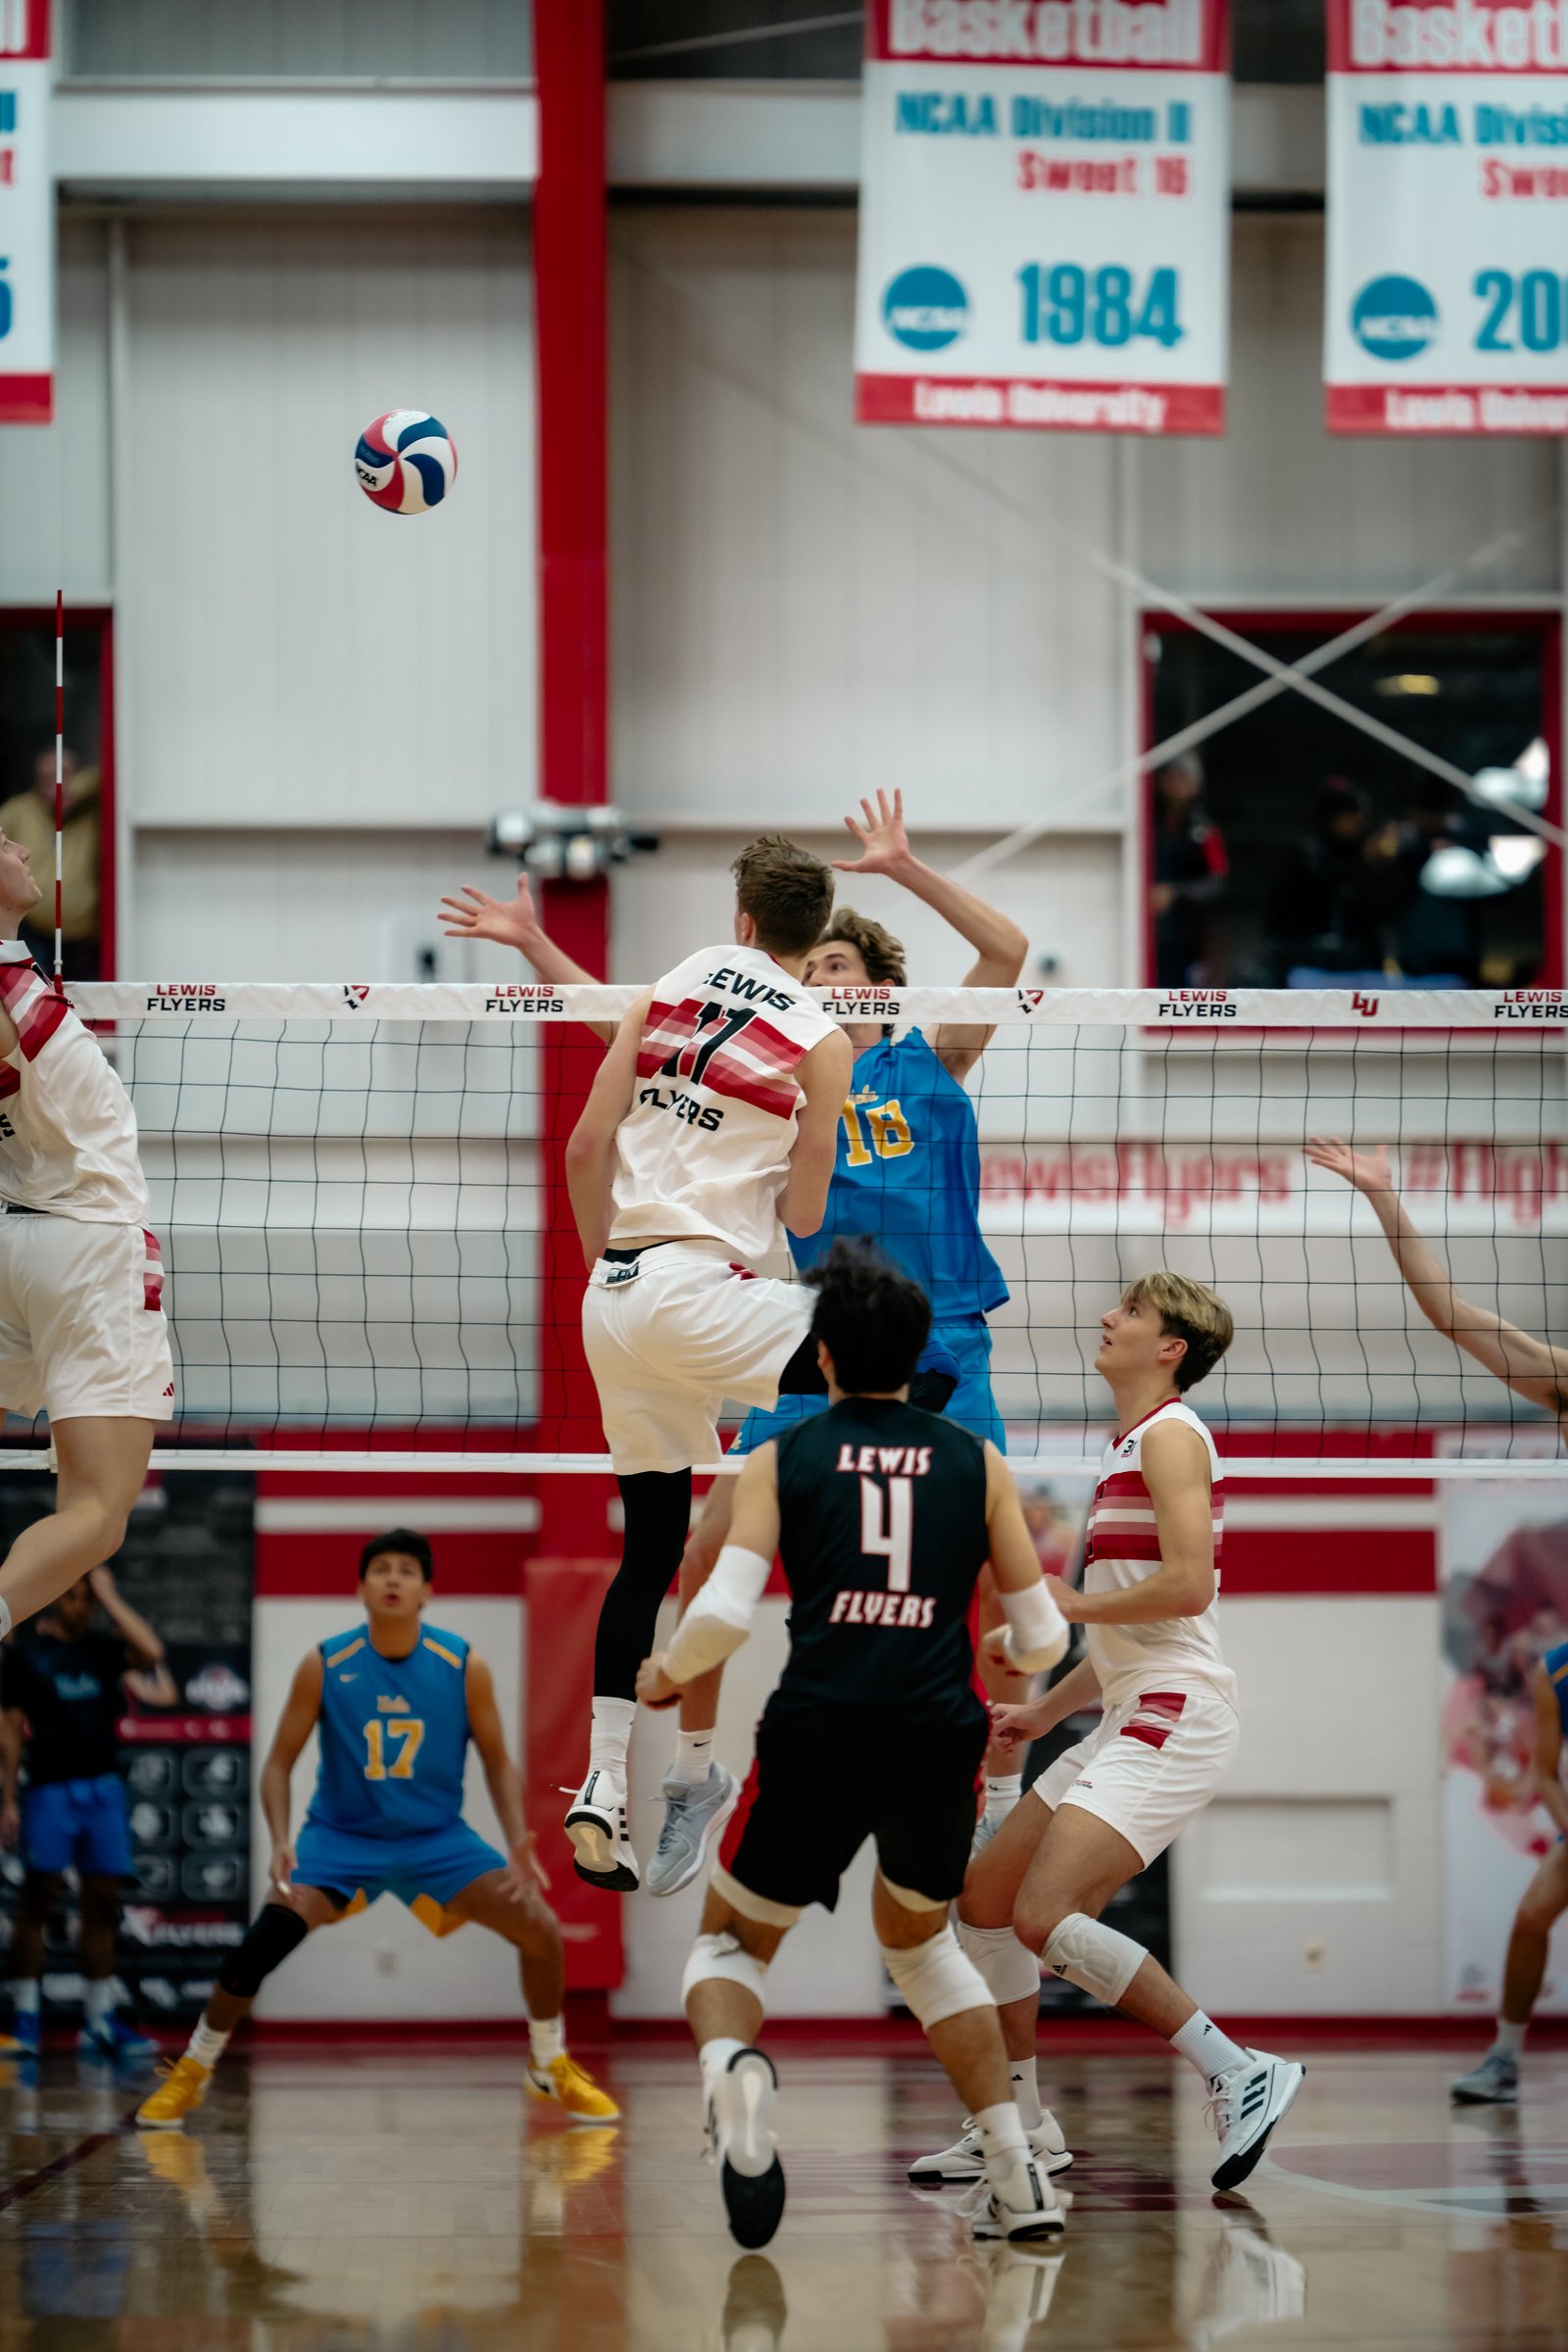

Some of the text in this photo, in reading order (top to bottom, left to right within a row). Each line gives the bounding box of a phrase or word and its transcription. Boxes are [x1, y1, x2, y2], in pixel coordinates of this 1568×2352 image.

[890, 0, 1201, 63] Basketball
[1351, 0, 1568, 67] Basket
[896, 91, 1001, 136] NCAA
[1011, 95, 1154, 143] Division
[1359, 104, 1461, 144] NCAA
[1019, 150, 1188, 196] Sweet 16
[1481, 156, 1568, 199] Swe
[1016, 263, 1185, 347] 1984
[1474, 268, 1568, 353] 20
[147, 998, 226, 1011] FLYERS
[157, 984, 217, 997] LEWIS
[485, 1000, 564, 1012] FLYERS
[495, 986, 555, 998] LEWIS
[822, 1002, 901, 1015] FLYERS
[831, 988, 891, 1000] LEWIS
[1168, 990, 1227, 1002] LEWIS
[1503, 991, 1563, 1003] LEWIS
[1158, 1004, 1238, 1017] FLYERS
[1494, 1004, 1568, 1018] FLYERS
[661, 1001, 758, 1086] 11
[842, 1099, 915, 1167] 18
[836, 1444, 933, 1477] LEWIS
[859, 1474, 913, 1592] 4
[828, 1590, 937, 1629] FLYERS
[364, 1719, 425, 1781] 17
